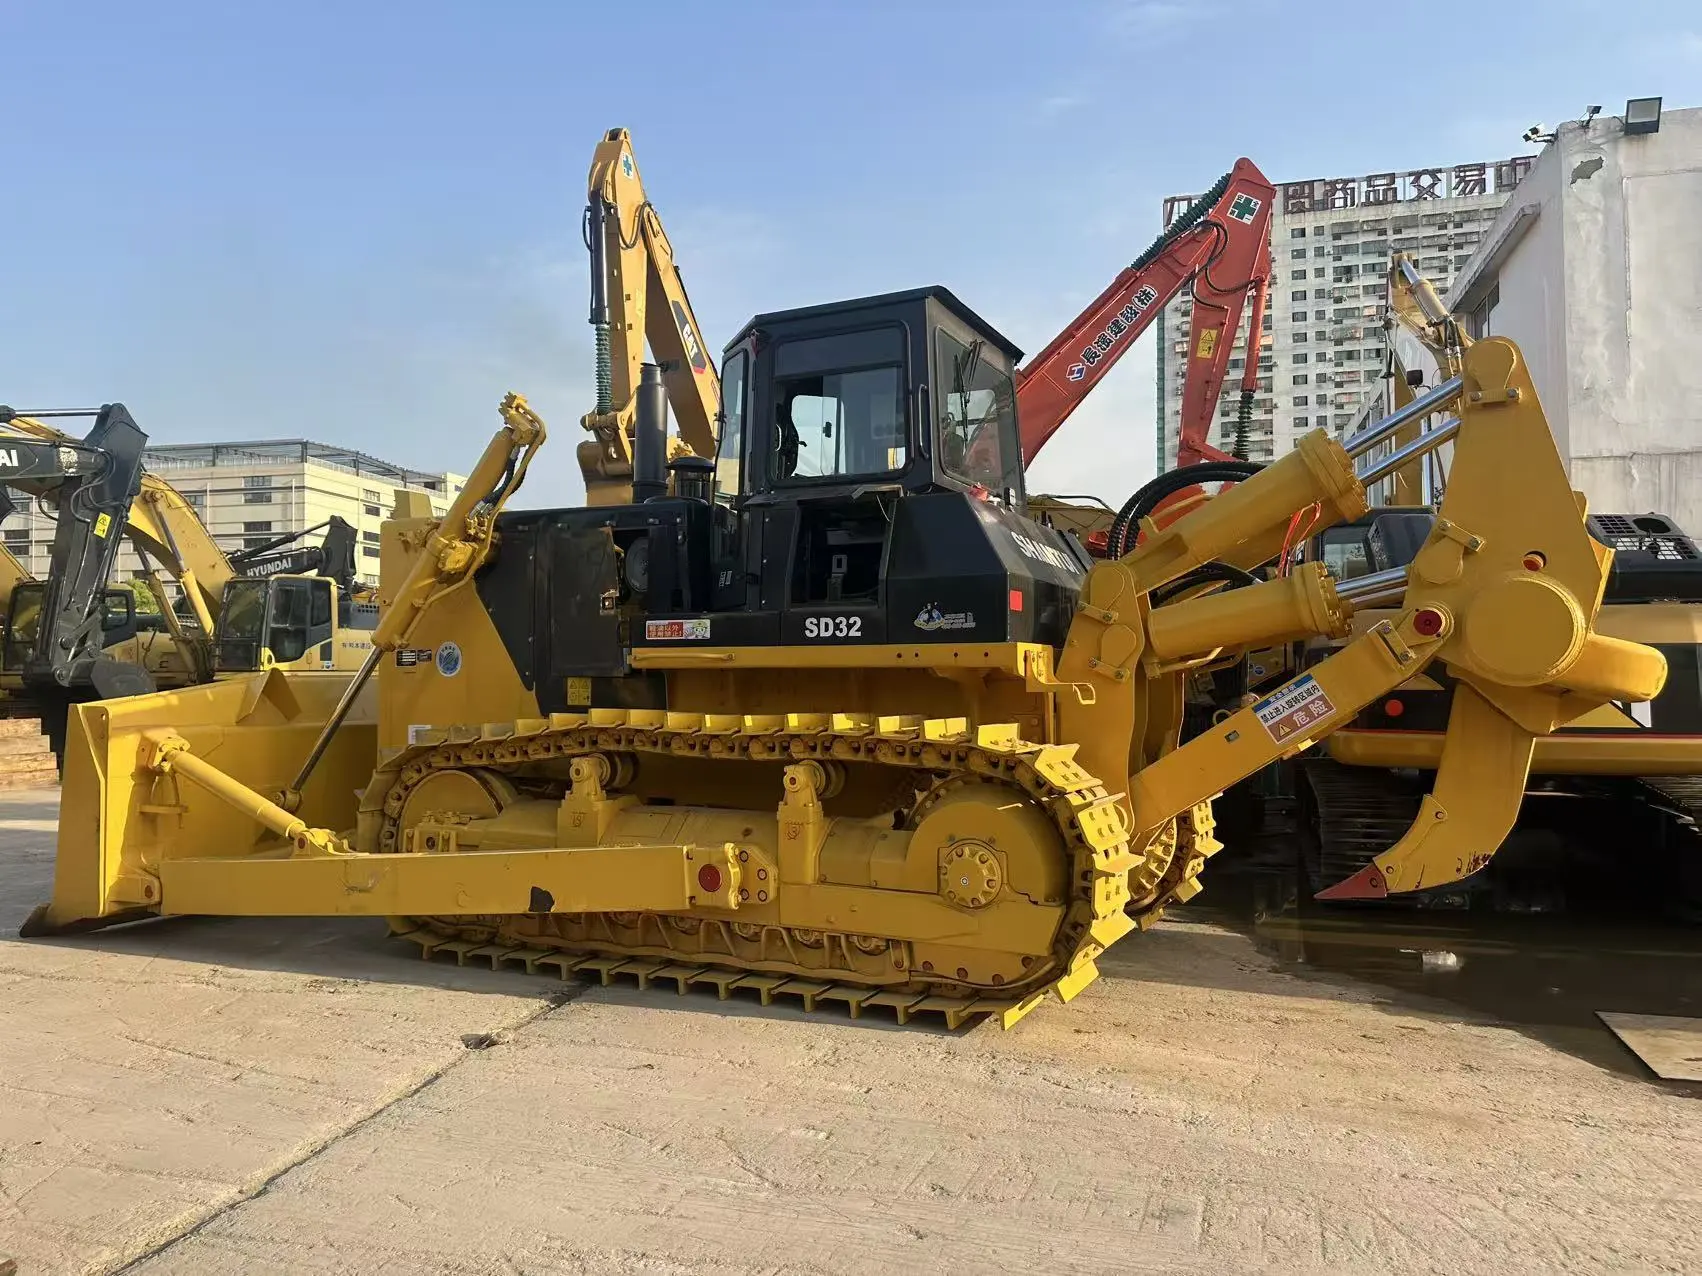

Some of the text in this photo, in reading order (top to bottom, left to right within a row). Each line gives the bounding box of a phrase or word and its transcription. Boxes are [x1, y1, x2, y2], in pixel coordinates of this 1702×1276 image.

[683, 323, 698, 359] CAT
[246, 557, 292, 577] HYUNDAI
[1011, 531, 1080, 574] SHANTUI
[804, 617, 862, 638] SD32
[1260, 684, 1321, 723] 禁止进入旋转区域内
[1292, 700, 1328, 727] 危险
